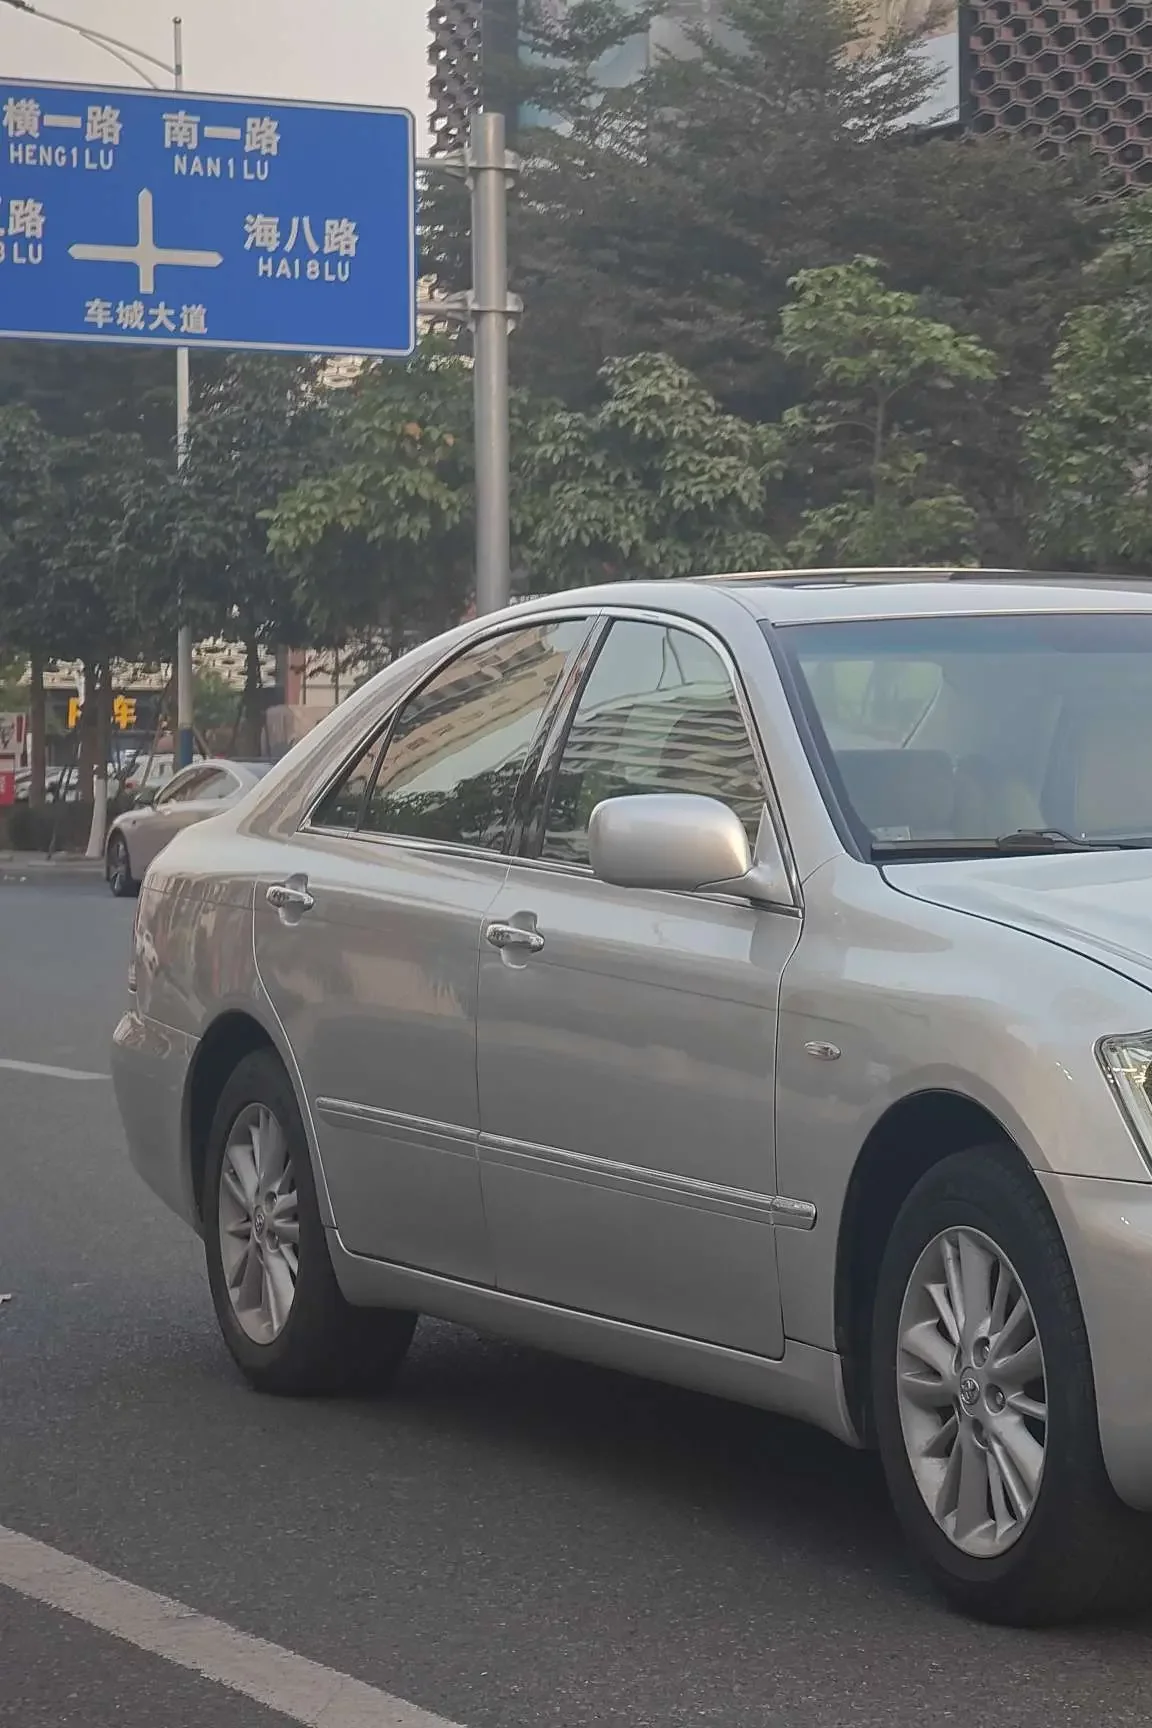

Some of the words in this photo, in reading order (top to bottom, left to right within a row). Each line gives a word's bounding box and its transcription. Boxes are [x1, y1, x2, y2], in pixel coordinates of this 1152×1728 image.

[2, 97, 122, 145] 横一路
[162, 110, 280, 156] 南一路
[243, 213, 359, 257] 海八路
[83, 297, 208, 334] 车城大道
